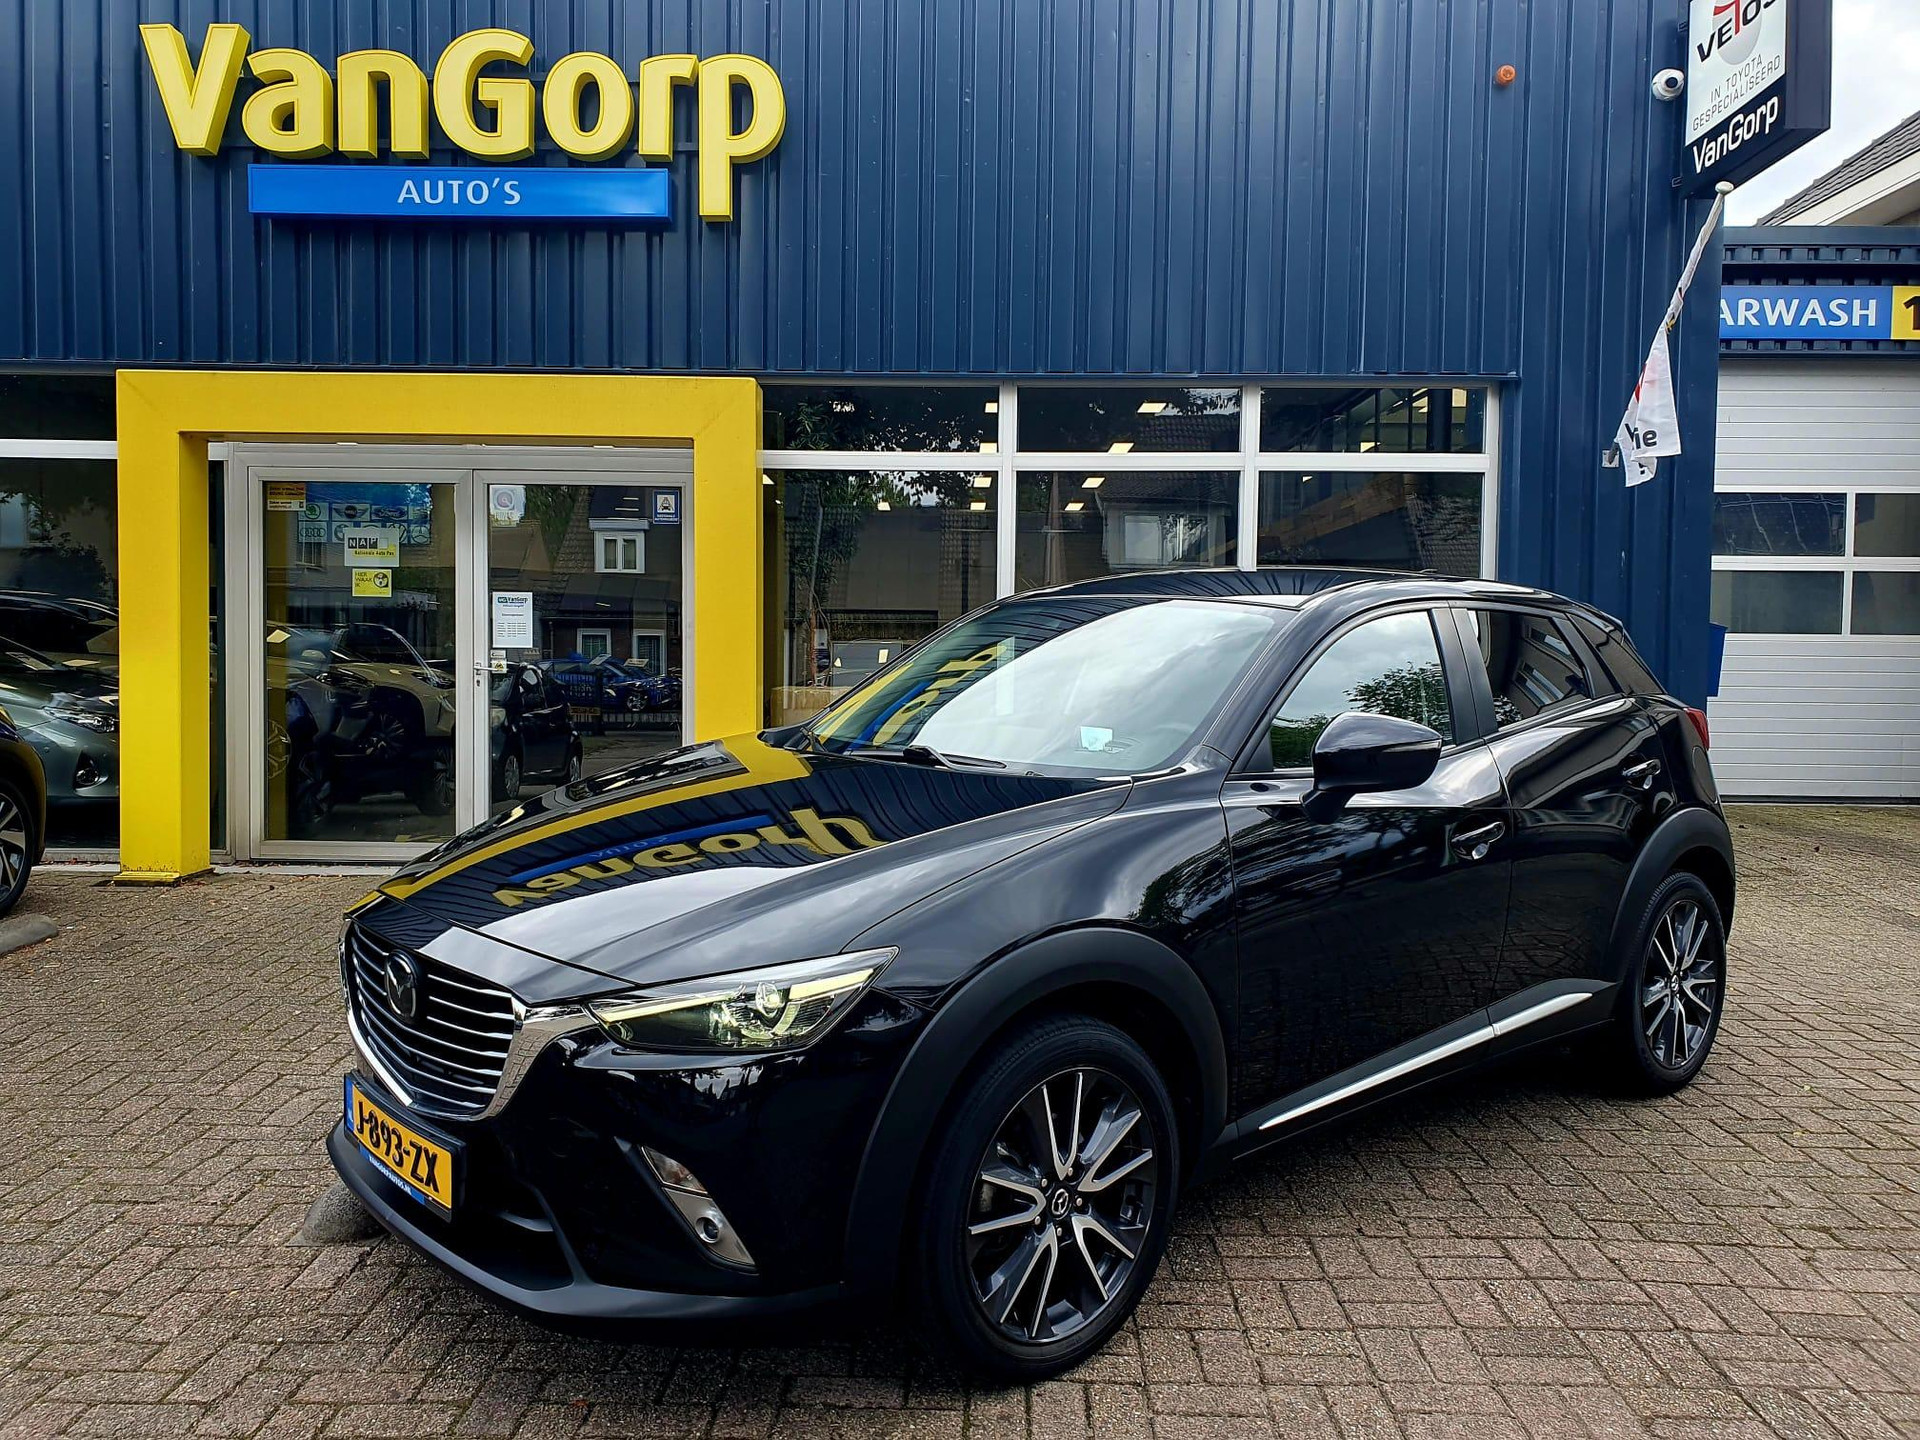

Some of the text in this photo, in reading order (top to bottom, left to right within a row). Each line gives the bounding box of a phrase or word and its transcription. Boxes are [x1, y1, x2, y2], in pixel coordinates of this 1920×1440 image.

[1693, 55, 1781, 131] GESPECIALISEERD
[1710, 53, 1764, 103] IN TOYOTA
[139, 23, 786, 222] VanGorp
[1692, 96, 1779, 174] VanGorp
[397, 179, 521, 206] AUTO'S
[1719, 298, 1876, 327] ARWASH
[348, 537, 377, 548] NAP
[356, 1101, 440, 1193] J-893-ZX
